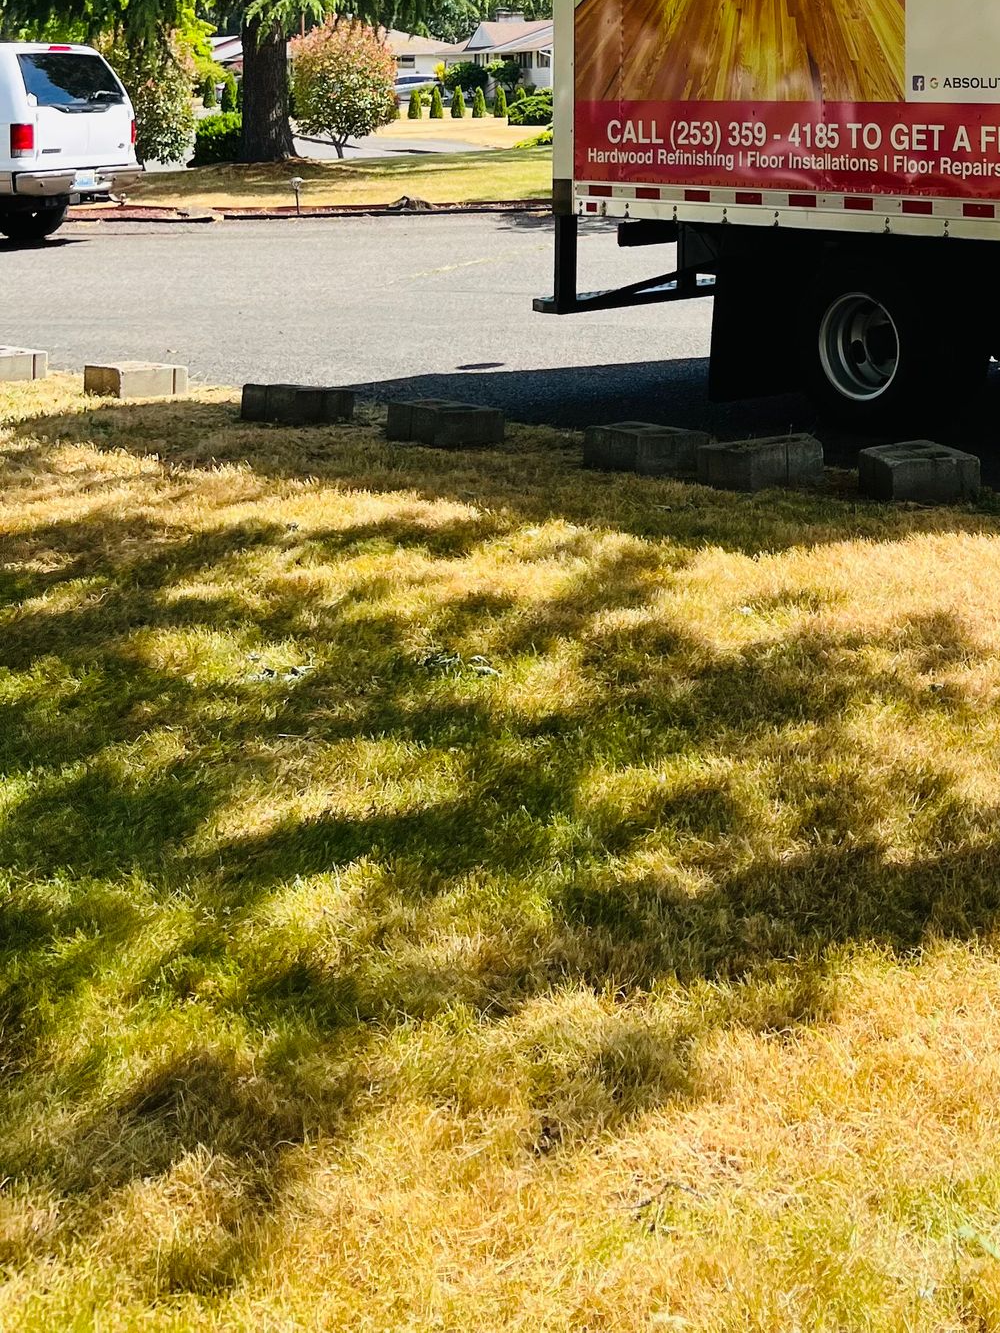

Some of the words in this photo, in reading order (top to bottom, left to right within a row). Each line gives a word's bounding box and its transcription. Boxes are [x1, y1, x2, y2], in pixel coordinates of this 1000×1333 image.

[606, 120, 664, 144] CALL
[670, 120, 722, 154] (253)
[728, 122, 767, 147] 359
[788, 122, 839, 149] 4185
[846, 123, 882, 150] TO
[890, 123, 944, 151] GET
[952, 125, 972, 152] A
[588, 148, 652, 164] Hardwood
[658, 148, 734, 170] Refinishing
[747, 151, 784, 168] Floor
[788, 152, 878, 172] Installations
[894, 155, 935, 174] Floor
